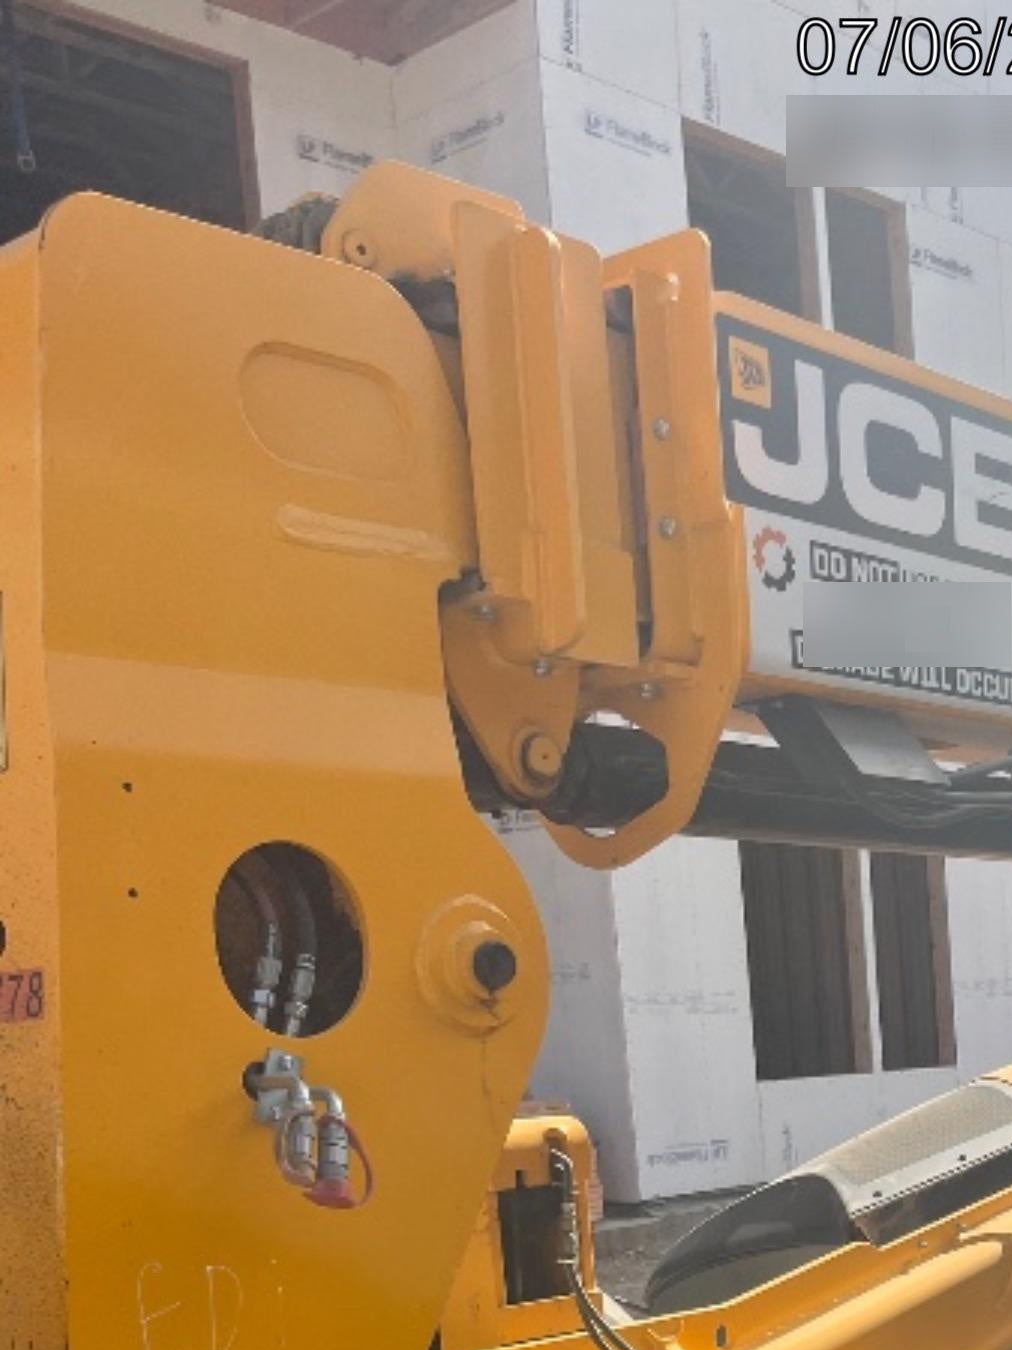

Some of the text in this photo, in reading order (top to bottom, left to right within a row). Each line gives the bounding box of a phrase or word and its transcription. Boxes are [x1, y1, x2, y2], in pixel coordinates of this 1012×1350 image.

[815, 548, 846, 579] DO
[852, 556, 900, 583] NOT
[0, 971, 44, 1018] 78
